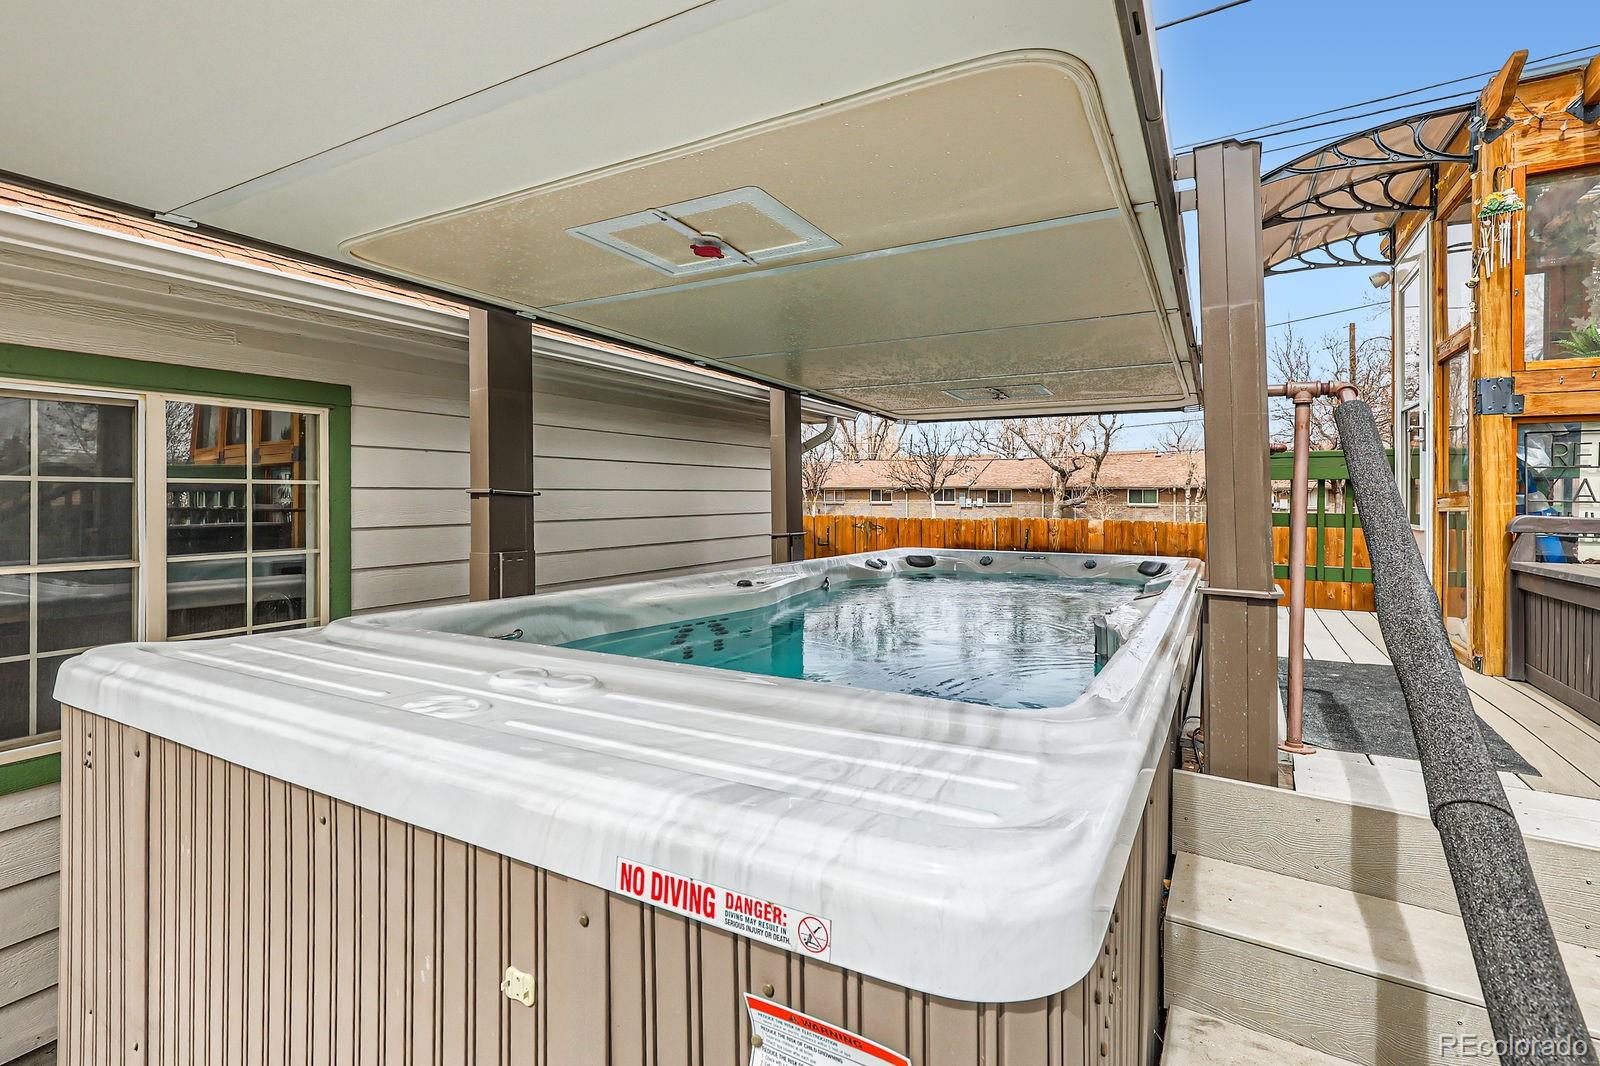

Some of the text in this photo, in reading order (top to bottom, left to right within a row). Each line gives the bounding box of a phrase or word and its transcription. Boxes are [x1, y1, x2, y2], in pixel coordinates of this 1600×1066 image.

[620, 862, 716, 919] NO DIVING
[724, 910, 787, 935] DIVING MAY RESULT IN
[725, 892, 788, 927] DANGER:
[724, 918, 745, 931] SERIOUS
[745, 924, 764, 937] INJURY
[764, 930, 772, 939] OR
[801, 1018, 864, 1049] WARNING
